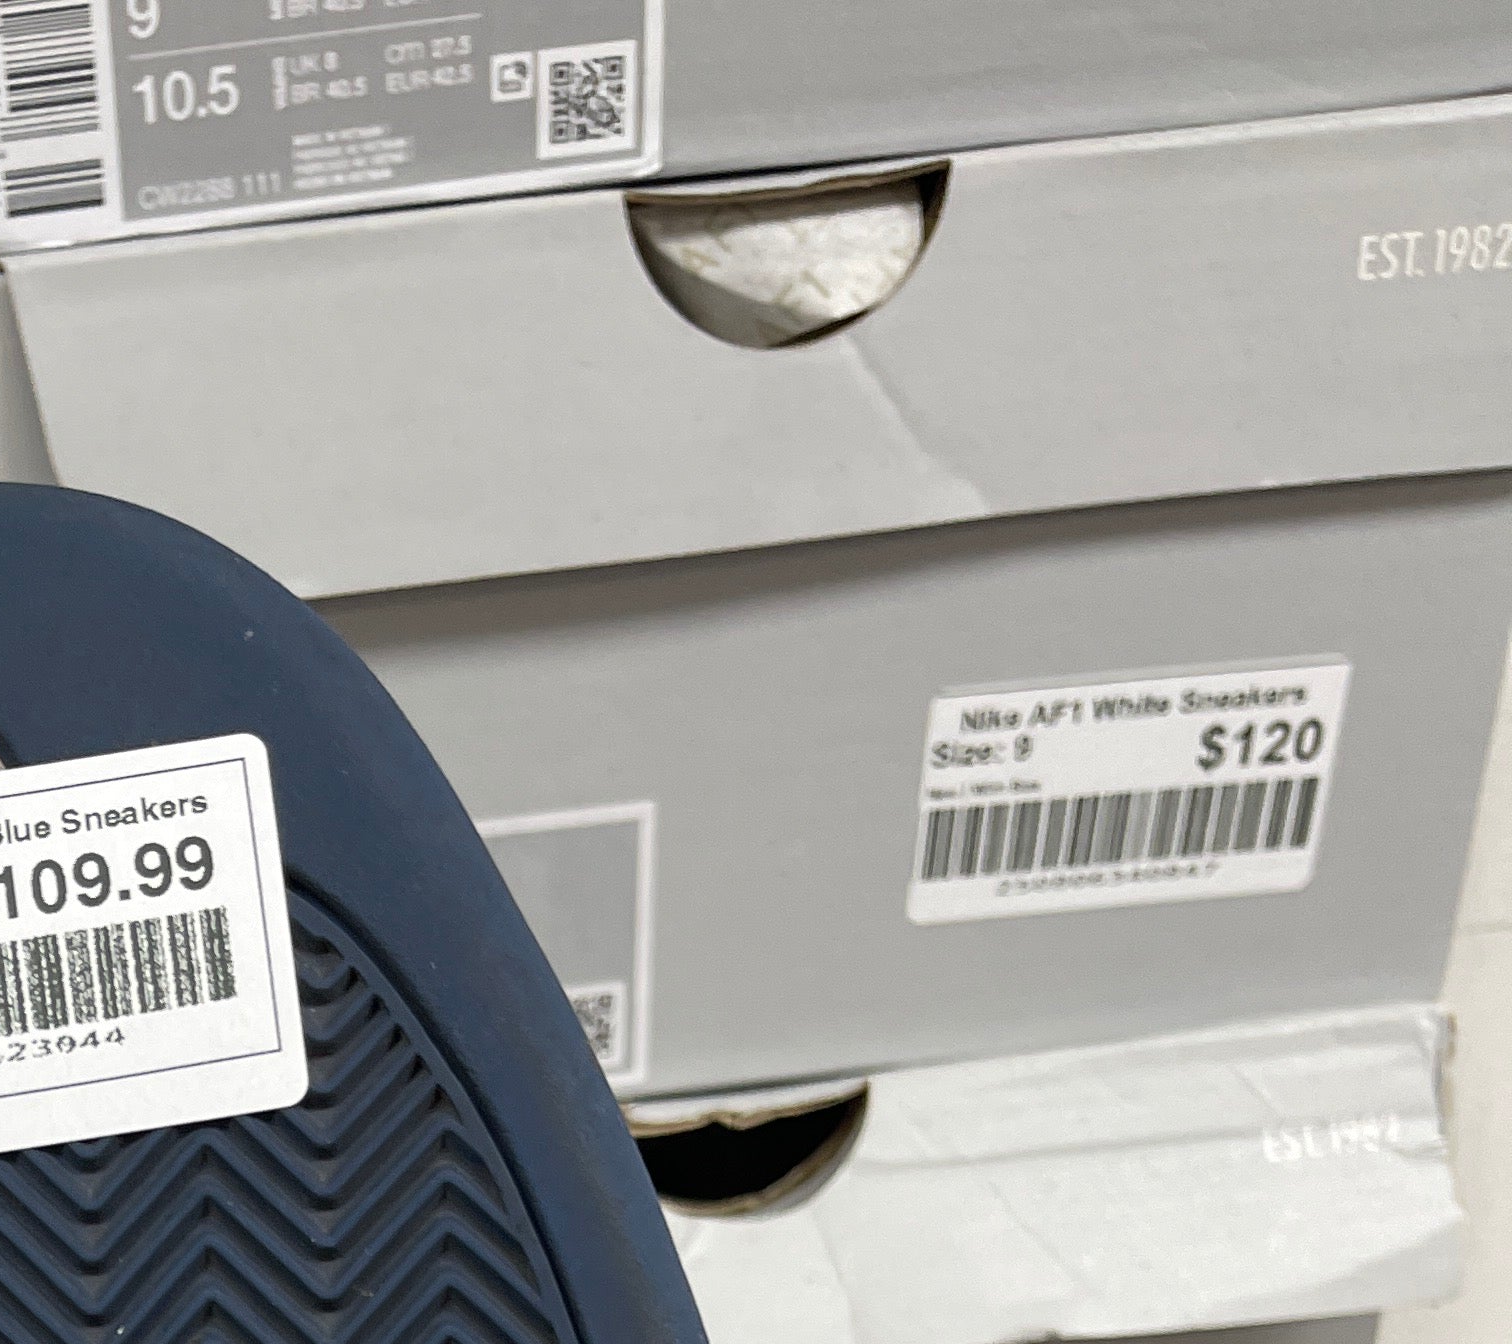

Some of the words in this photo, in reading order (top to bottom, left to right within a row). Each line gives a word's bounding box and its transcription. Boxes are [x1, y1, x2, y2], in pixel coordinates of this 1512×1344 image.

[132, 64, 239, 124] 10.5
[1196, 717, 1325, 773] $120
[61, 793, 209, 836] Sneakers
